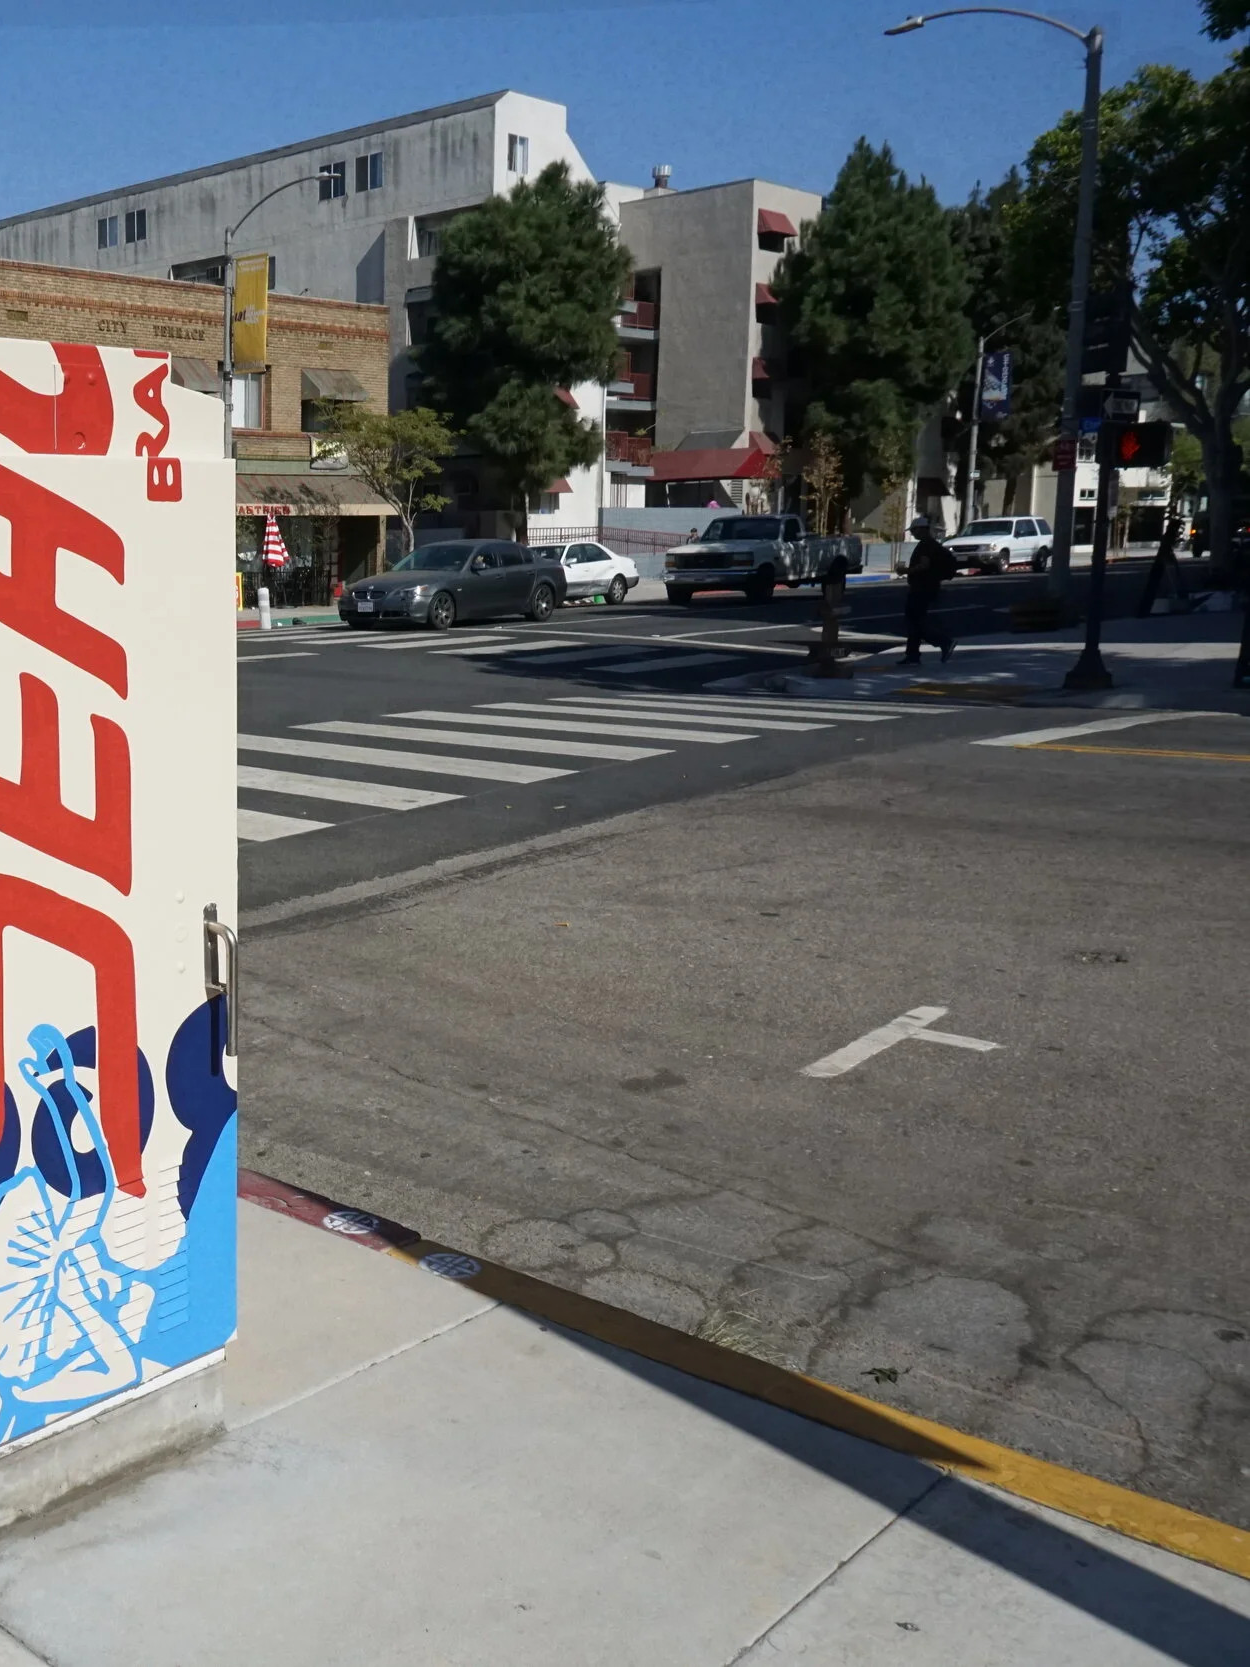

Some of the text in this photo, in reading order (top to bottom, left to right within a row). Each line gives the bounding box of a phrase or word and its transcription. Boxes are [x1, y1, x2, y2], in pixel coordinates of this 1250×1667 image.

[98, 319, 128, 333] CITY
[133, 350, 182, 502] BRA
[237, 505, 291, 515] ASTRIES
